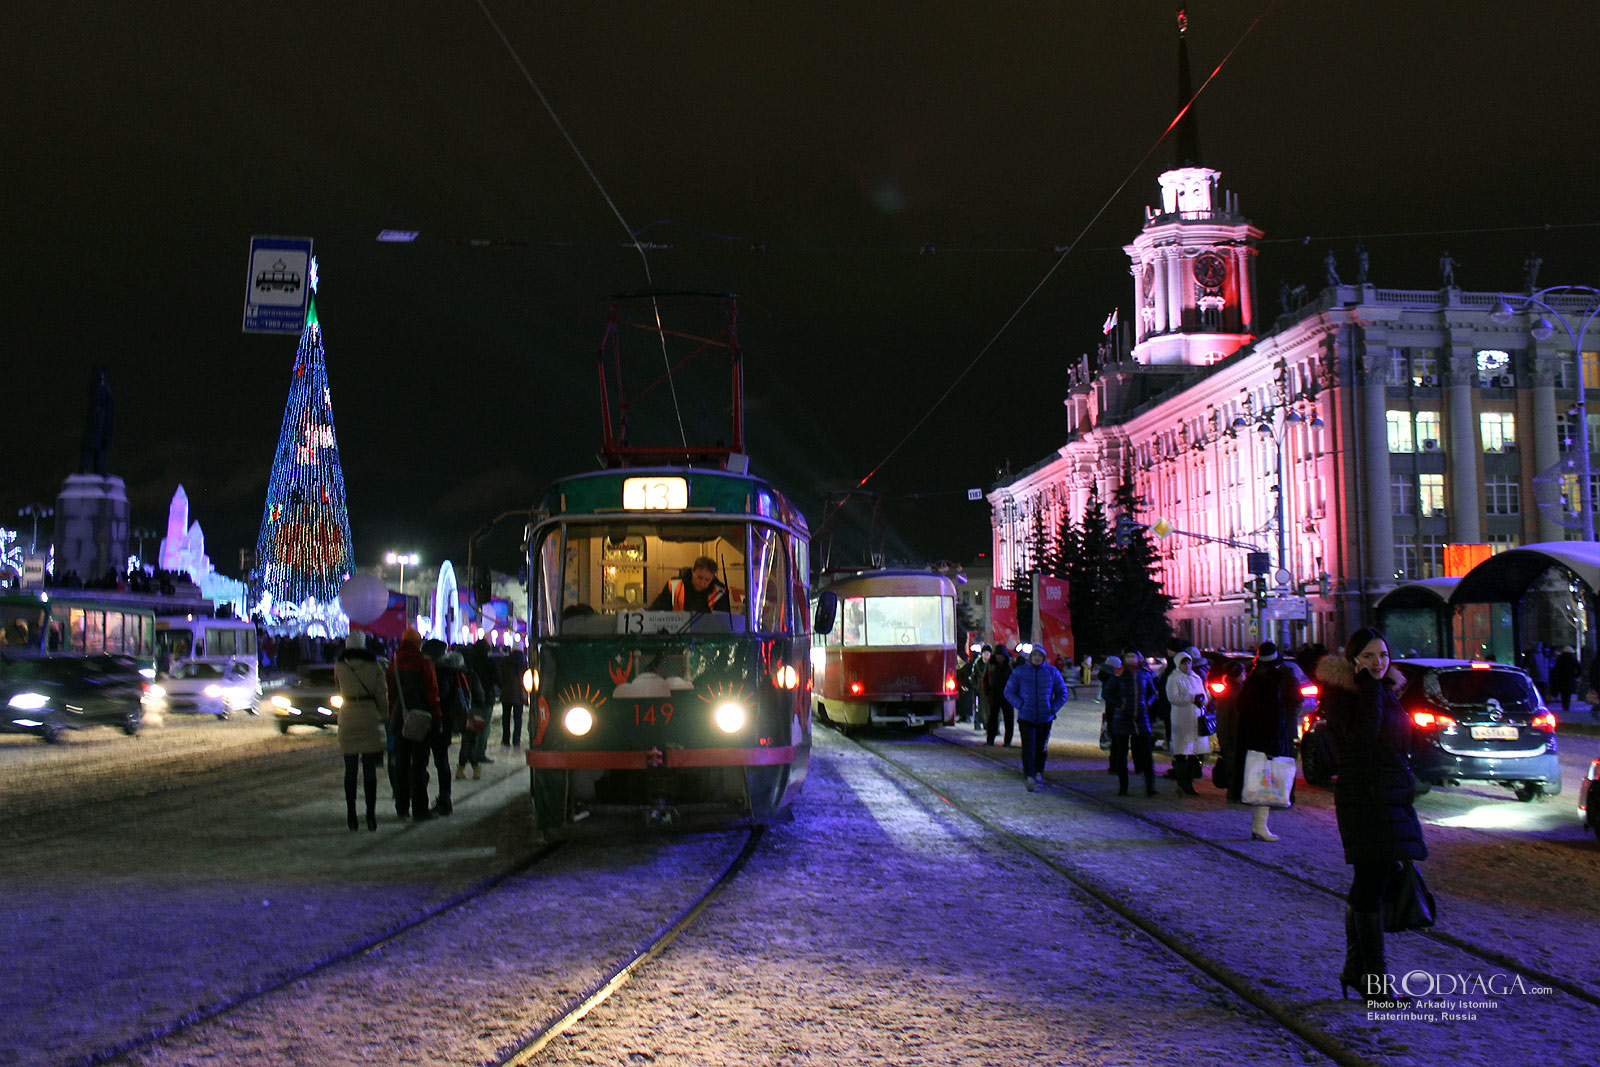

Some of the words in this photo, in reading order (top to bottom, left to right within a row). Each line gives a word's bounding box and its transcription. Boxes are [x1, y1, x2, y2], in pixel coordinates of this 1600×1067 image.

[641, 482, 670, 510] 13
[623, 613, 645, 635] 13
[901, 628, 910, 644] 6
[633, 702, 674, 726] 149
